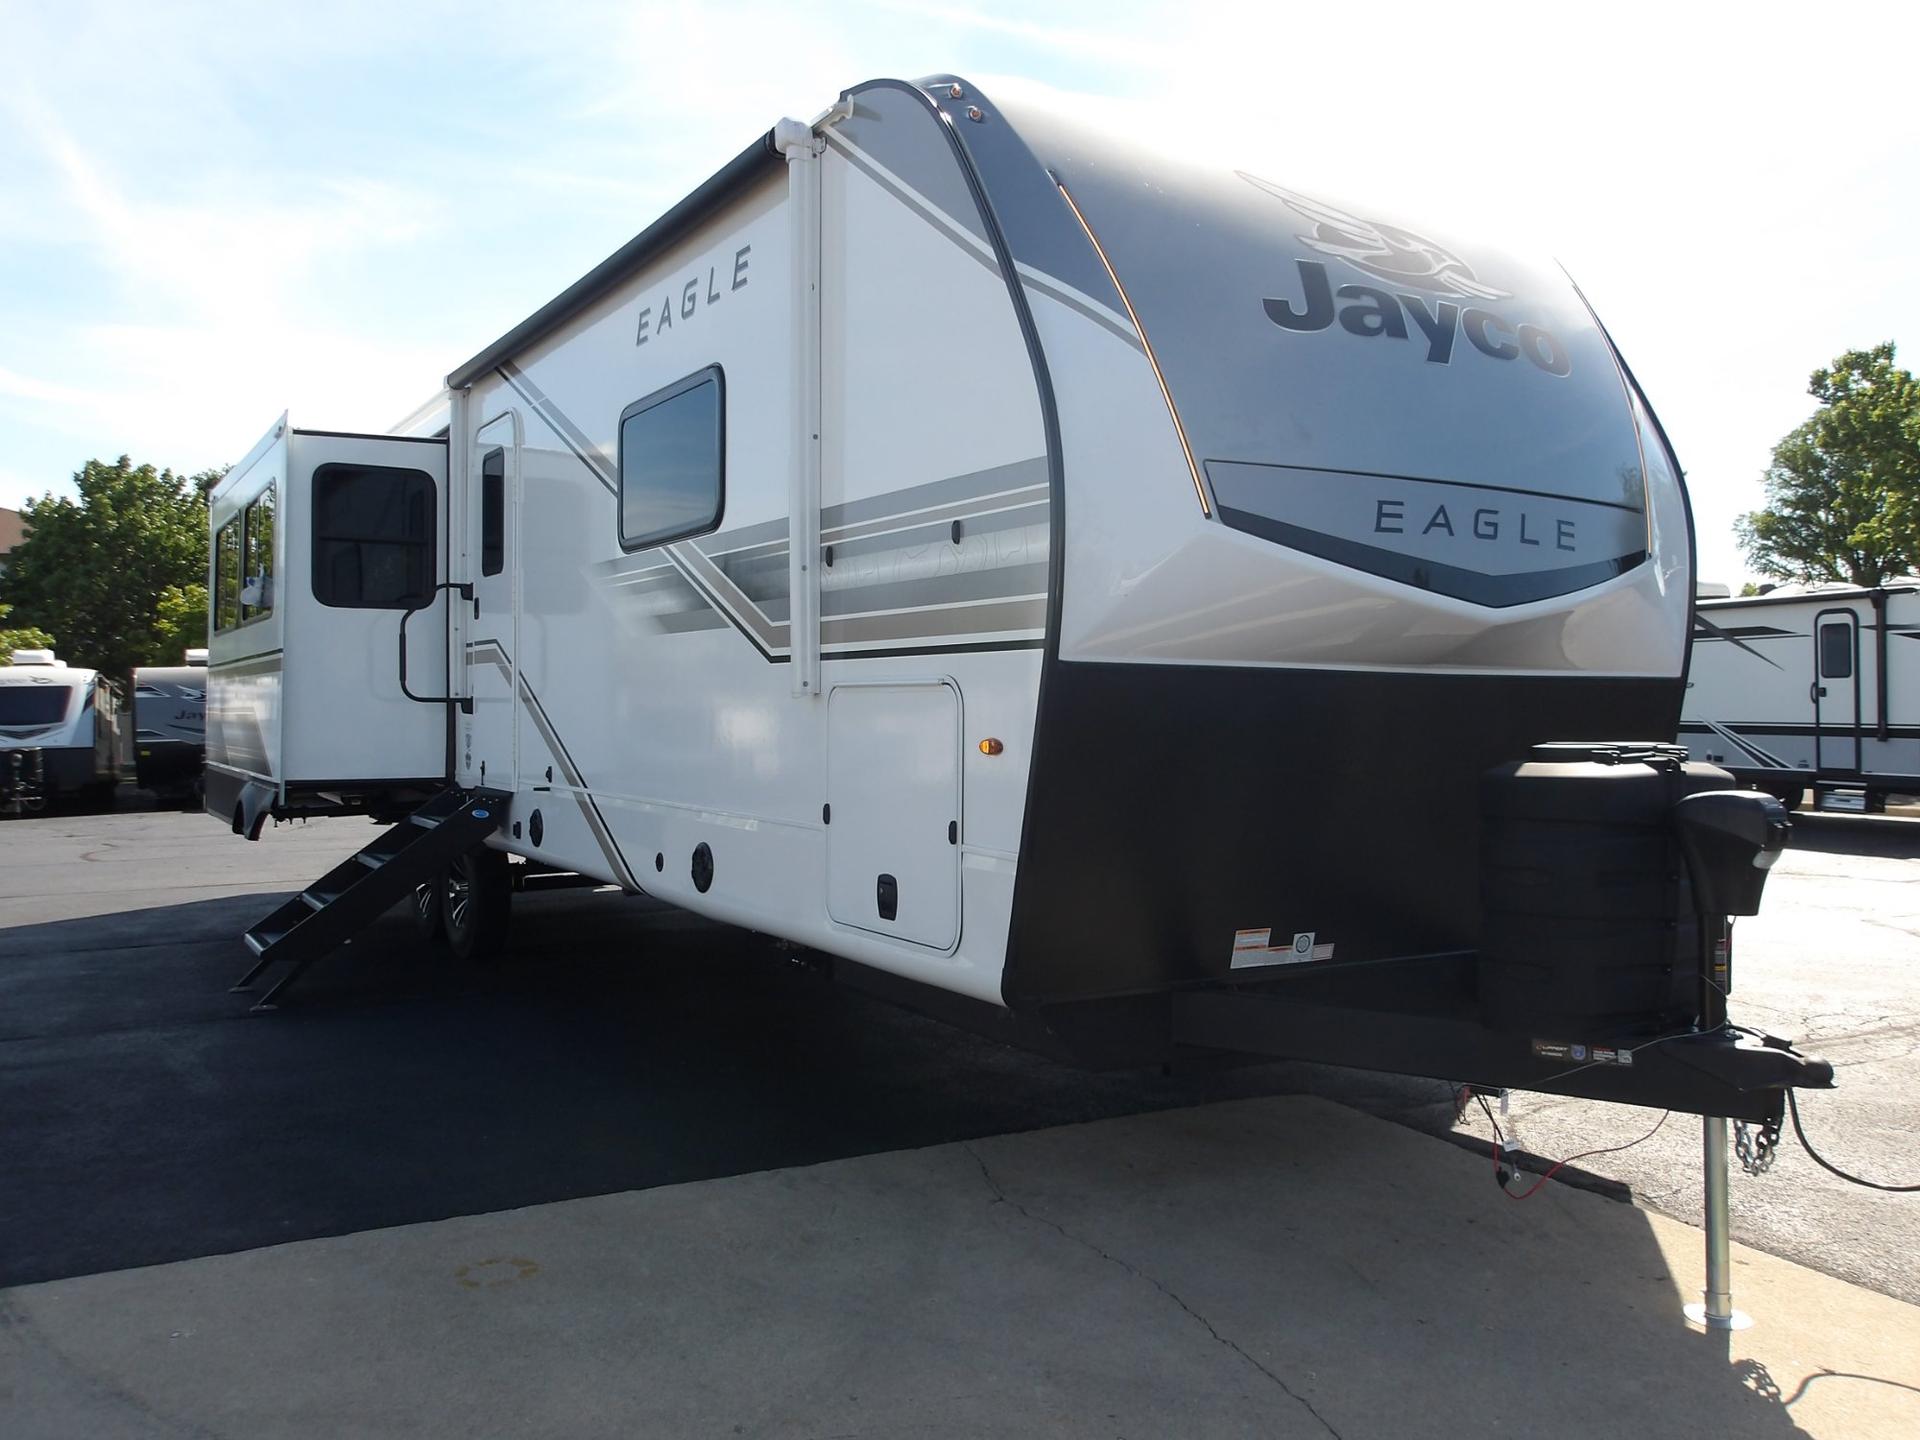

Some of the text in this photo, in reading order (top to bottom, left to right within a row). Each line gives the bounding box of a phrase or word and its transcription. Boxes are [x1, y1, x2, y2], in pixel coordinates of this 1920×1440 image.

[636, 244, 751, 347] EAGLE
[1262, 257, 1573, 377] Jayco
[1374, 499, 1577, 552] EAGLE
